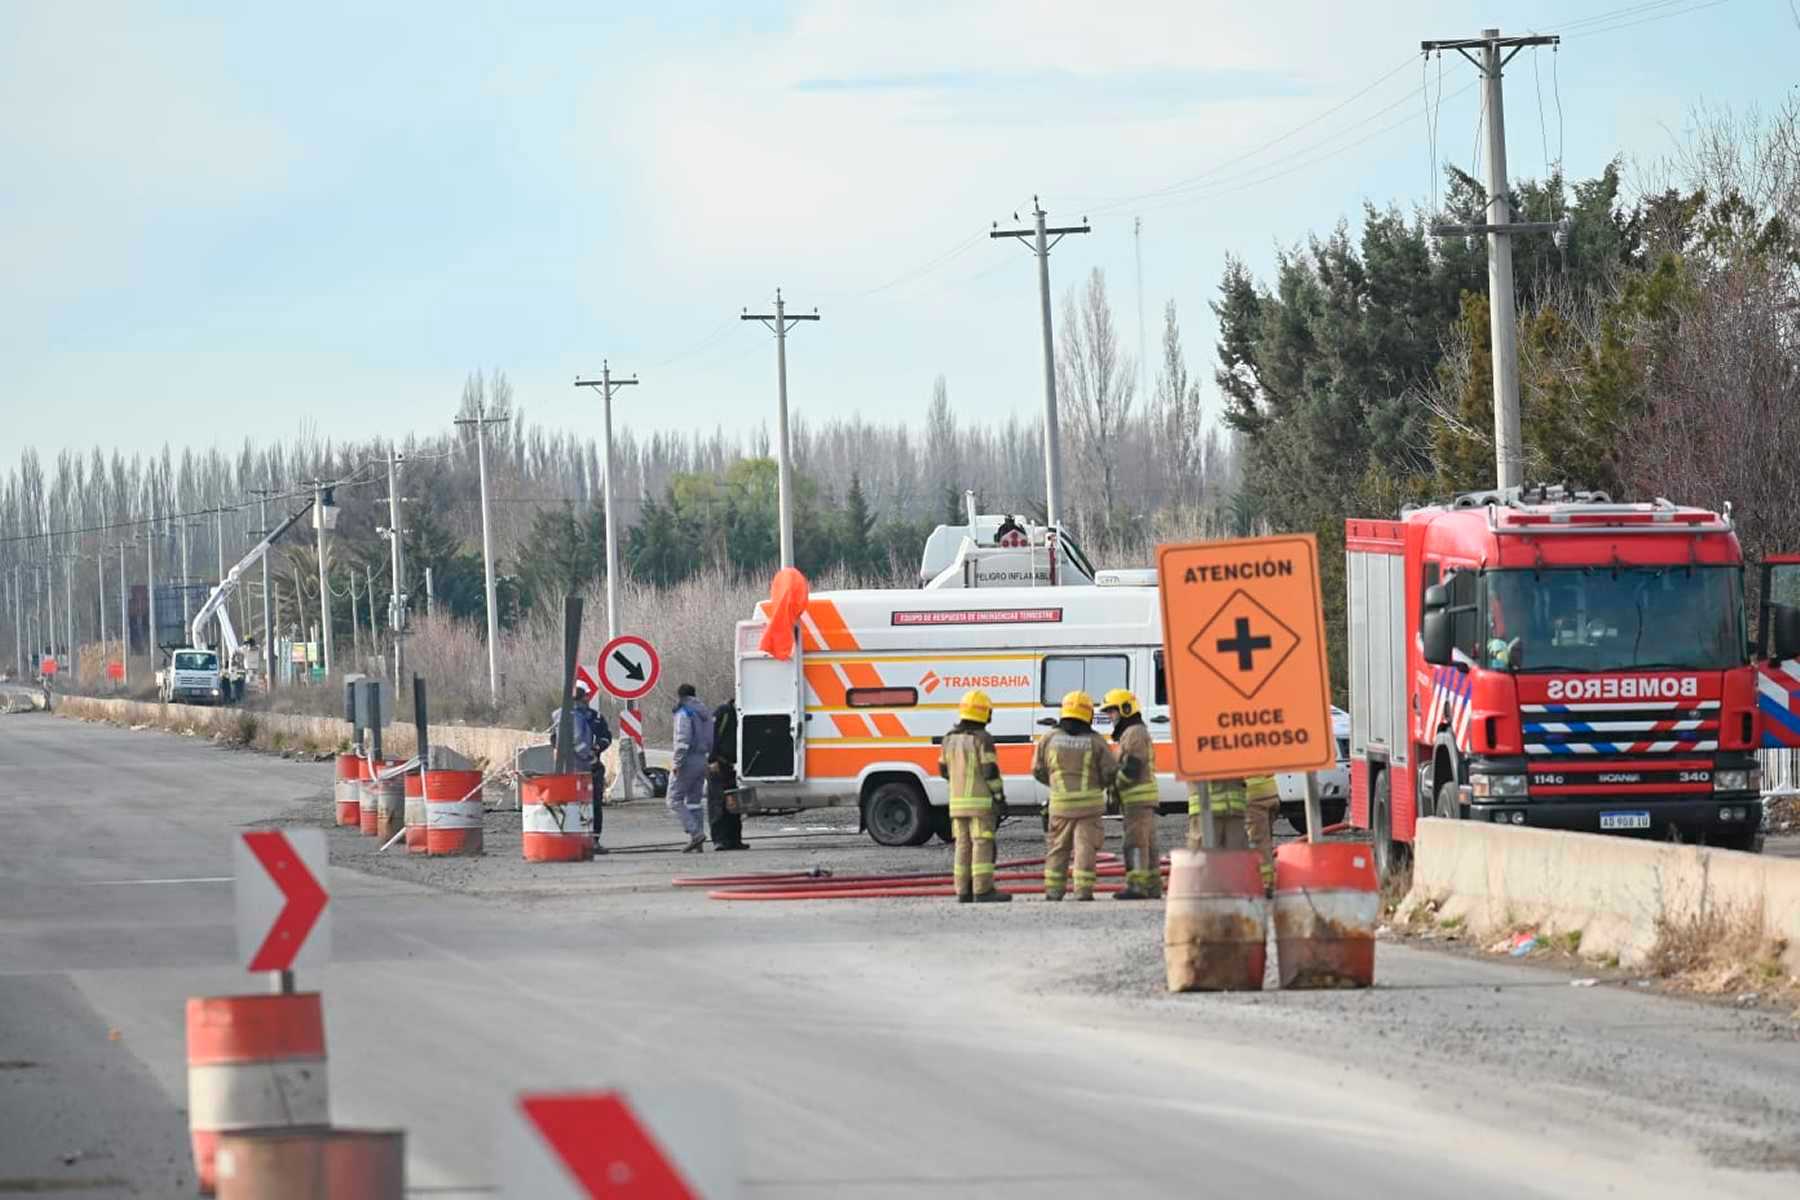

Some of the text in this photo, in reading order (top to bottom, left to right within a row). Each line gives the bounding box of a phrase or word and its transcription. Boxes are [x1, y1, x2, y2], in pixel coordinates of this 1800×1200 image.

[1184, 556, 1293, 583] ATENCIÓN
[975, 572, 1007, 581] PELIGRO
[943, 675, 1030, 688] TRANSBAHIA
[1217, 708, 1284, 728] CRUCE
[1197, 728, 1309, 752] PELIGROSO
[1598, 773, 1640, 782] SCANIA
[1679, 772, 1710, 782] 340
